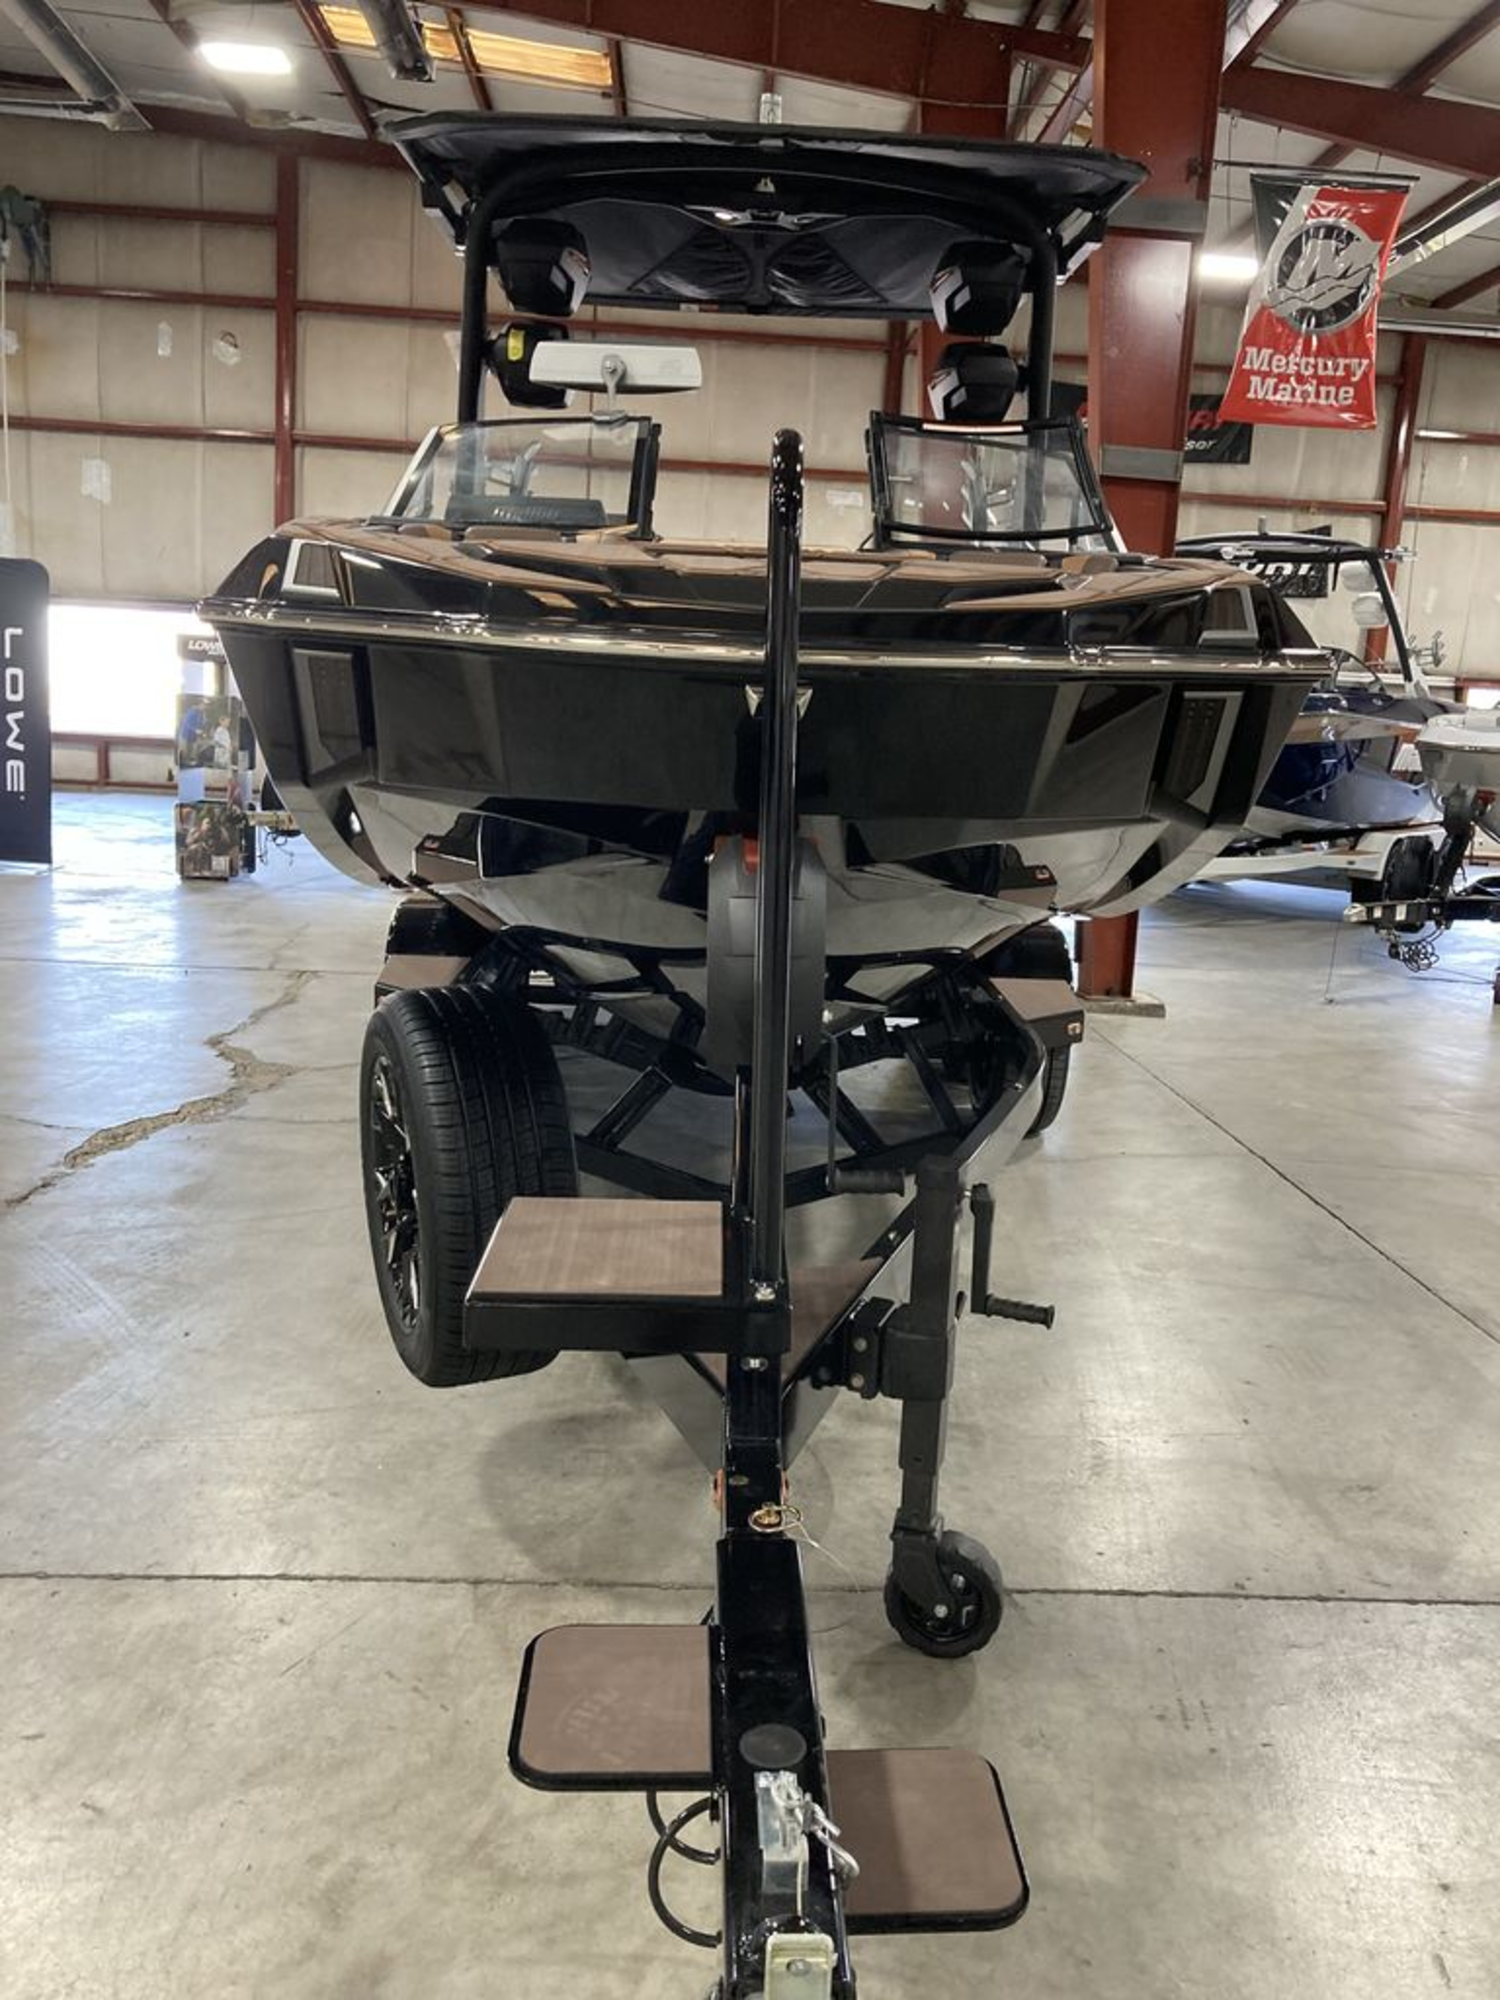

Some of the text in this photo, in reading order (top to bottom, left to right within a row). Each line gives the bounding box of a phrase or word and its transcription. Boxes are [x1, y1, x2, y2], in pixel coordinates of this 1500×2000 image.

[1242, 346, 1369, 381] Mercury
[1247, 376, 1354, 405] Marine
[187, 640, 222, 651] LOW
[4, 626, 25, 792] LOWE
